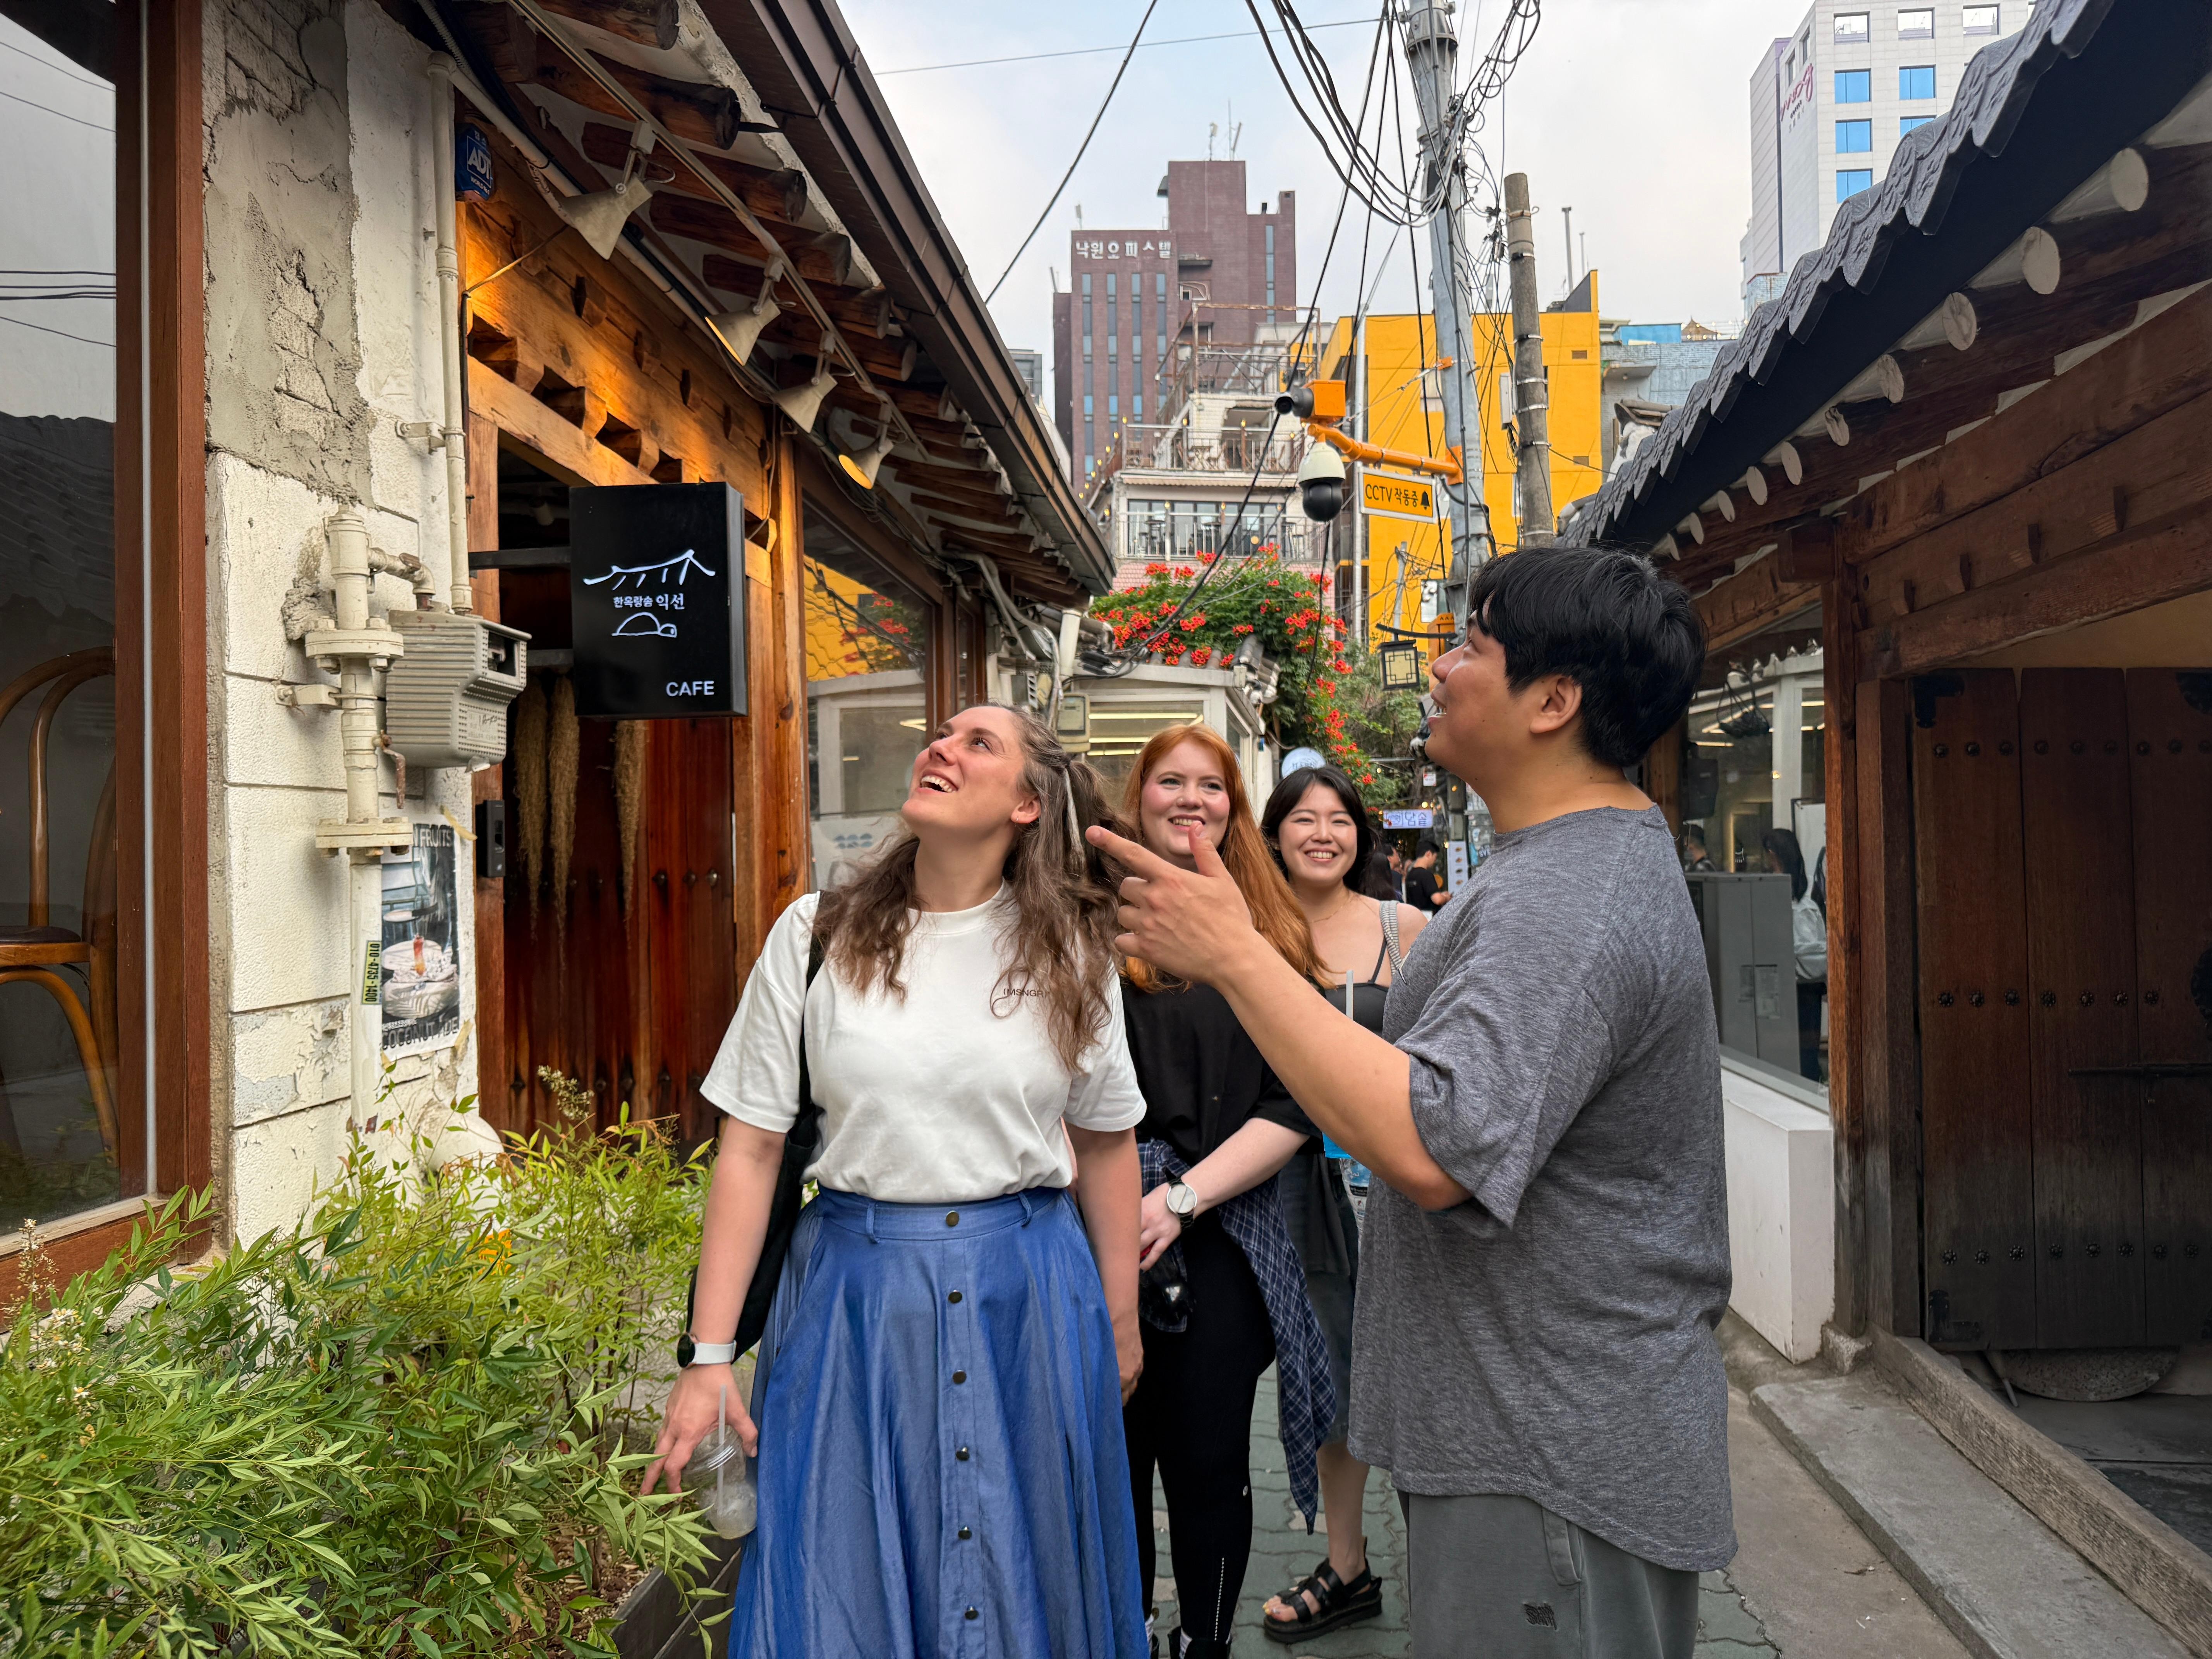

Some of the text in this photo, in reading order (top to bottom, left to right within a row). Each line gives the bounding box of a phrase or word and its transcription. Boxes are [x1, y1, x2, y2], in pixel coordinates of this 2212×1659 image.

[467, 147, 491, 180] ADT
[1075, 240, 1171, 259] 낙원오피스텔
[1365, 484, 1418, 507] CCTV 작동중
[613, 593, 685, 610] 한옥랑솜 익선
[666, 680, 714, 696] CAFE
[420, 828, 452, 847] FRUITS
[365, 943, 380, 1002] 010-4735-1400
[381, 1016, 458, 1050] COCONUT ADE
